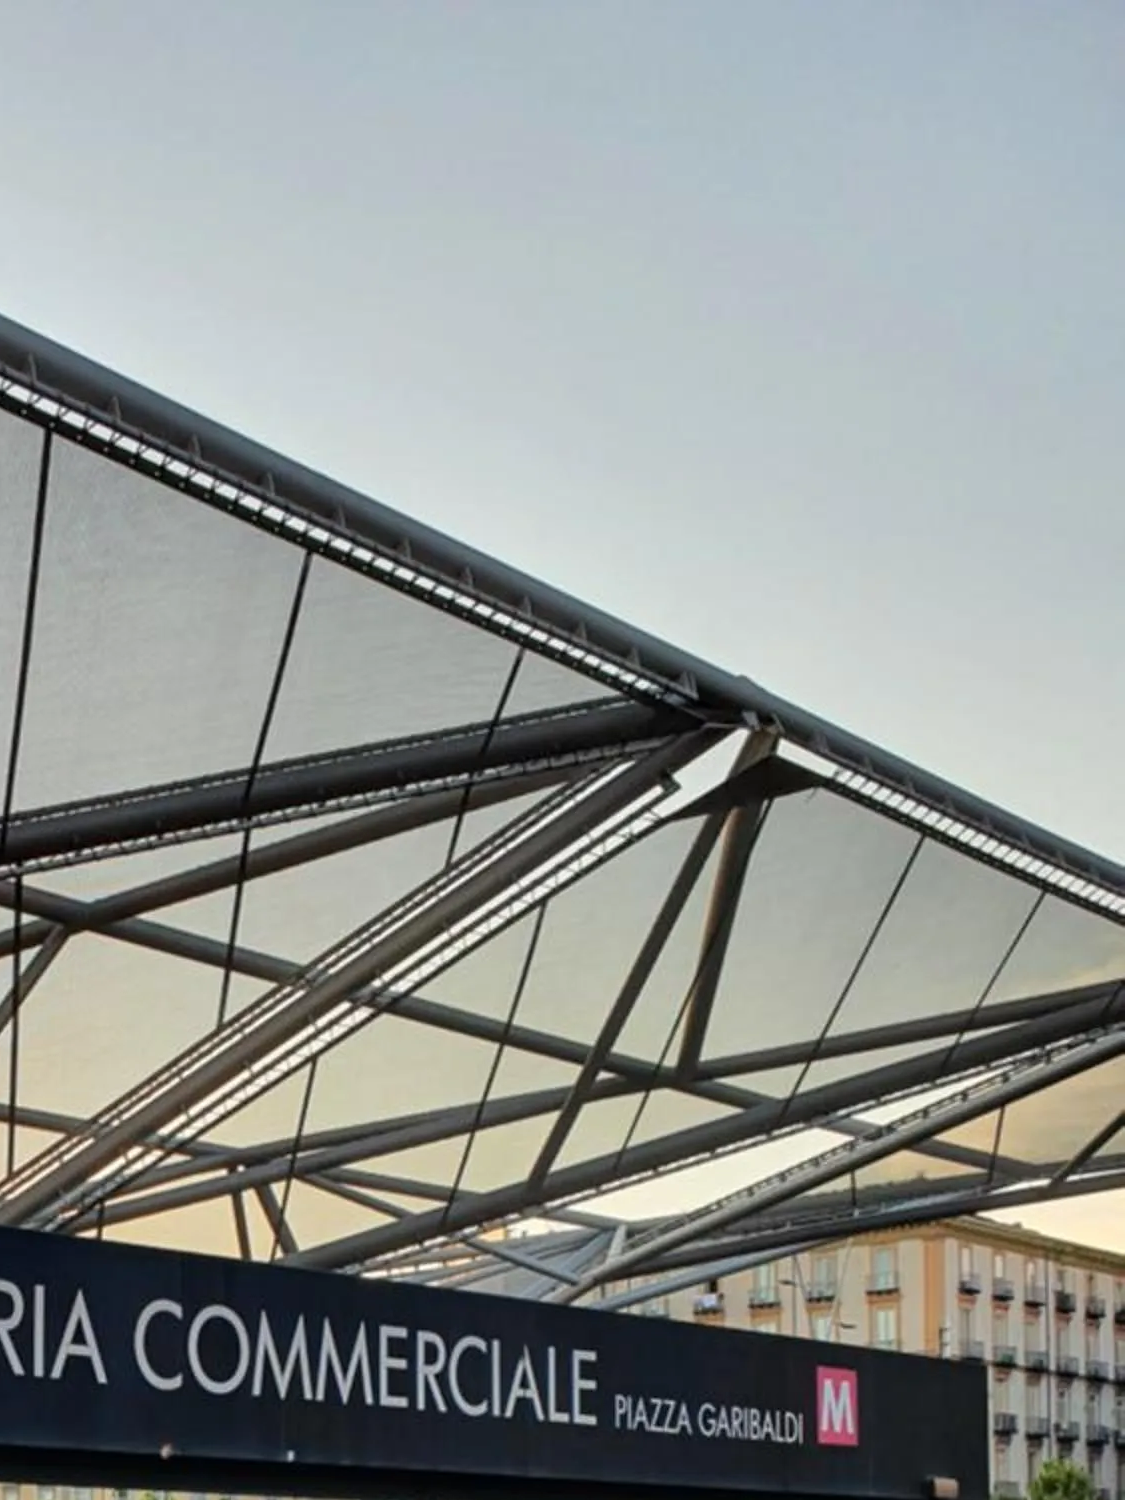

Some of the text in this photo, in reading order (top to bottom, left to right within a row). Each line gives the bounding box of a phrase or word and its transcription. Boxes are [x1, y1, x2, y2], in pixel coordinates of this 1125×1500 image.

[133, 1298, 598, 1426] COMMERCIALE
[614, 1394, 692, 1436] PIAZZA
[698, 1402, 805, 1445] GARIBALDI
[820, 1377, 856, 1435] M
